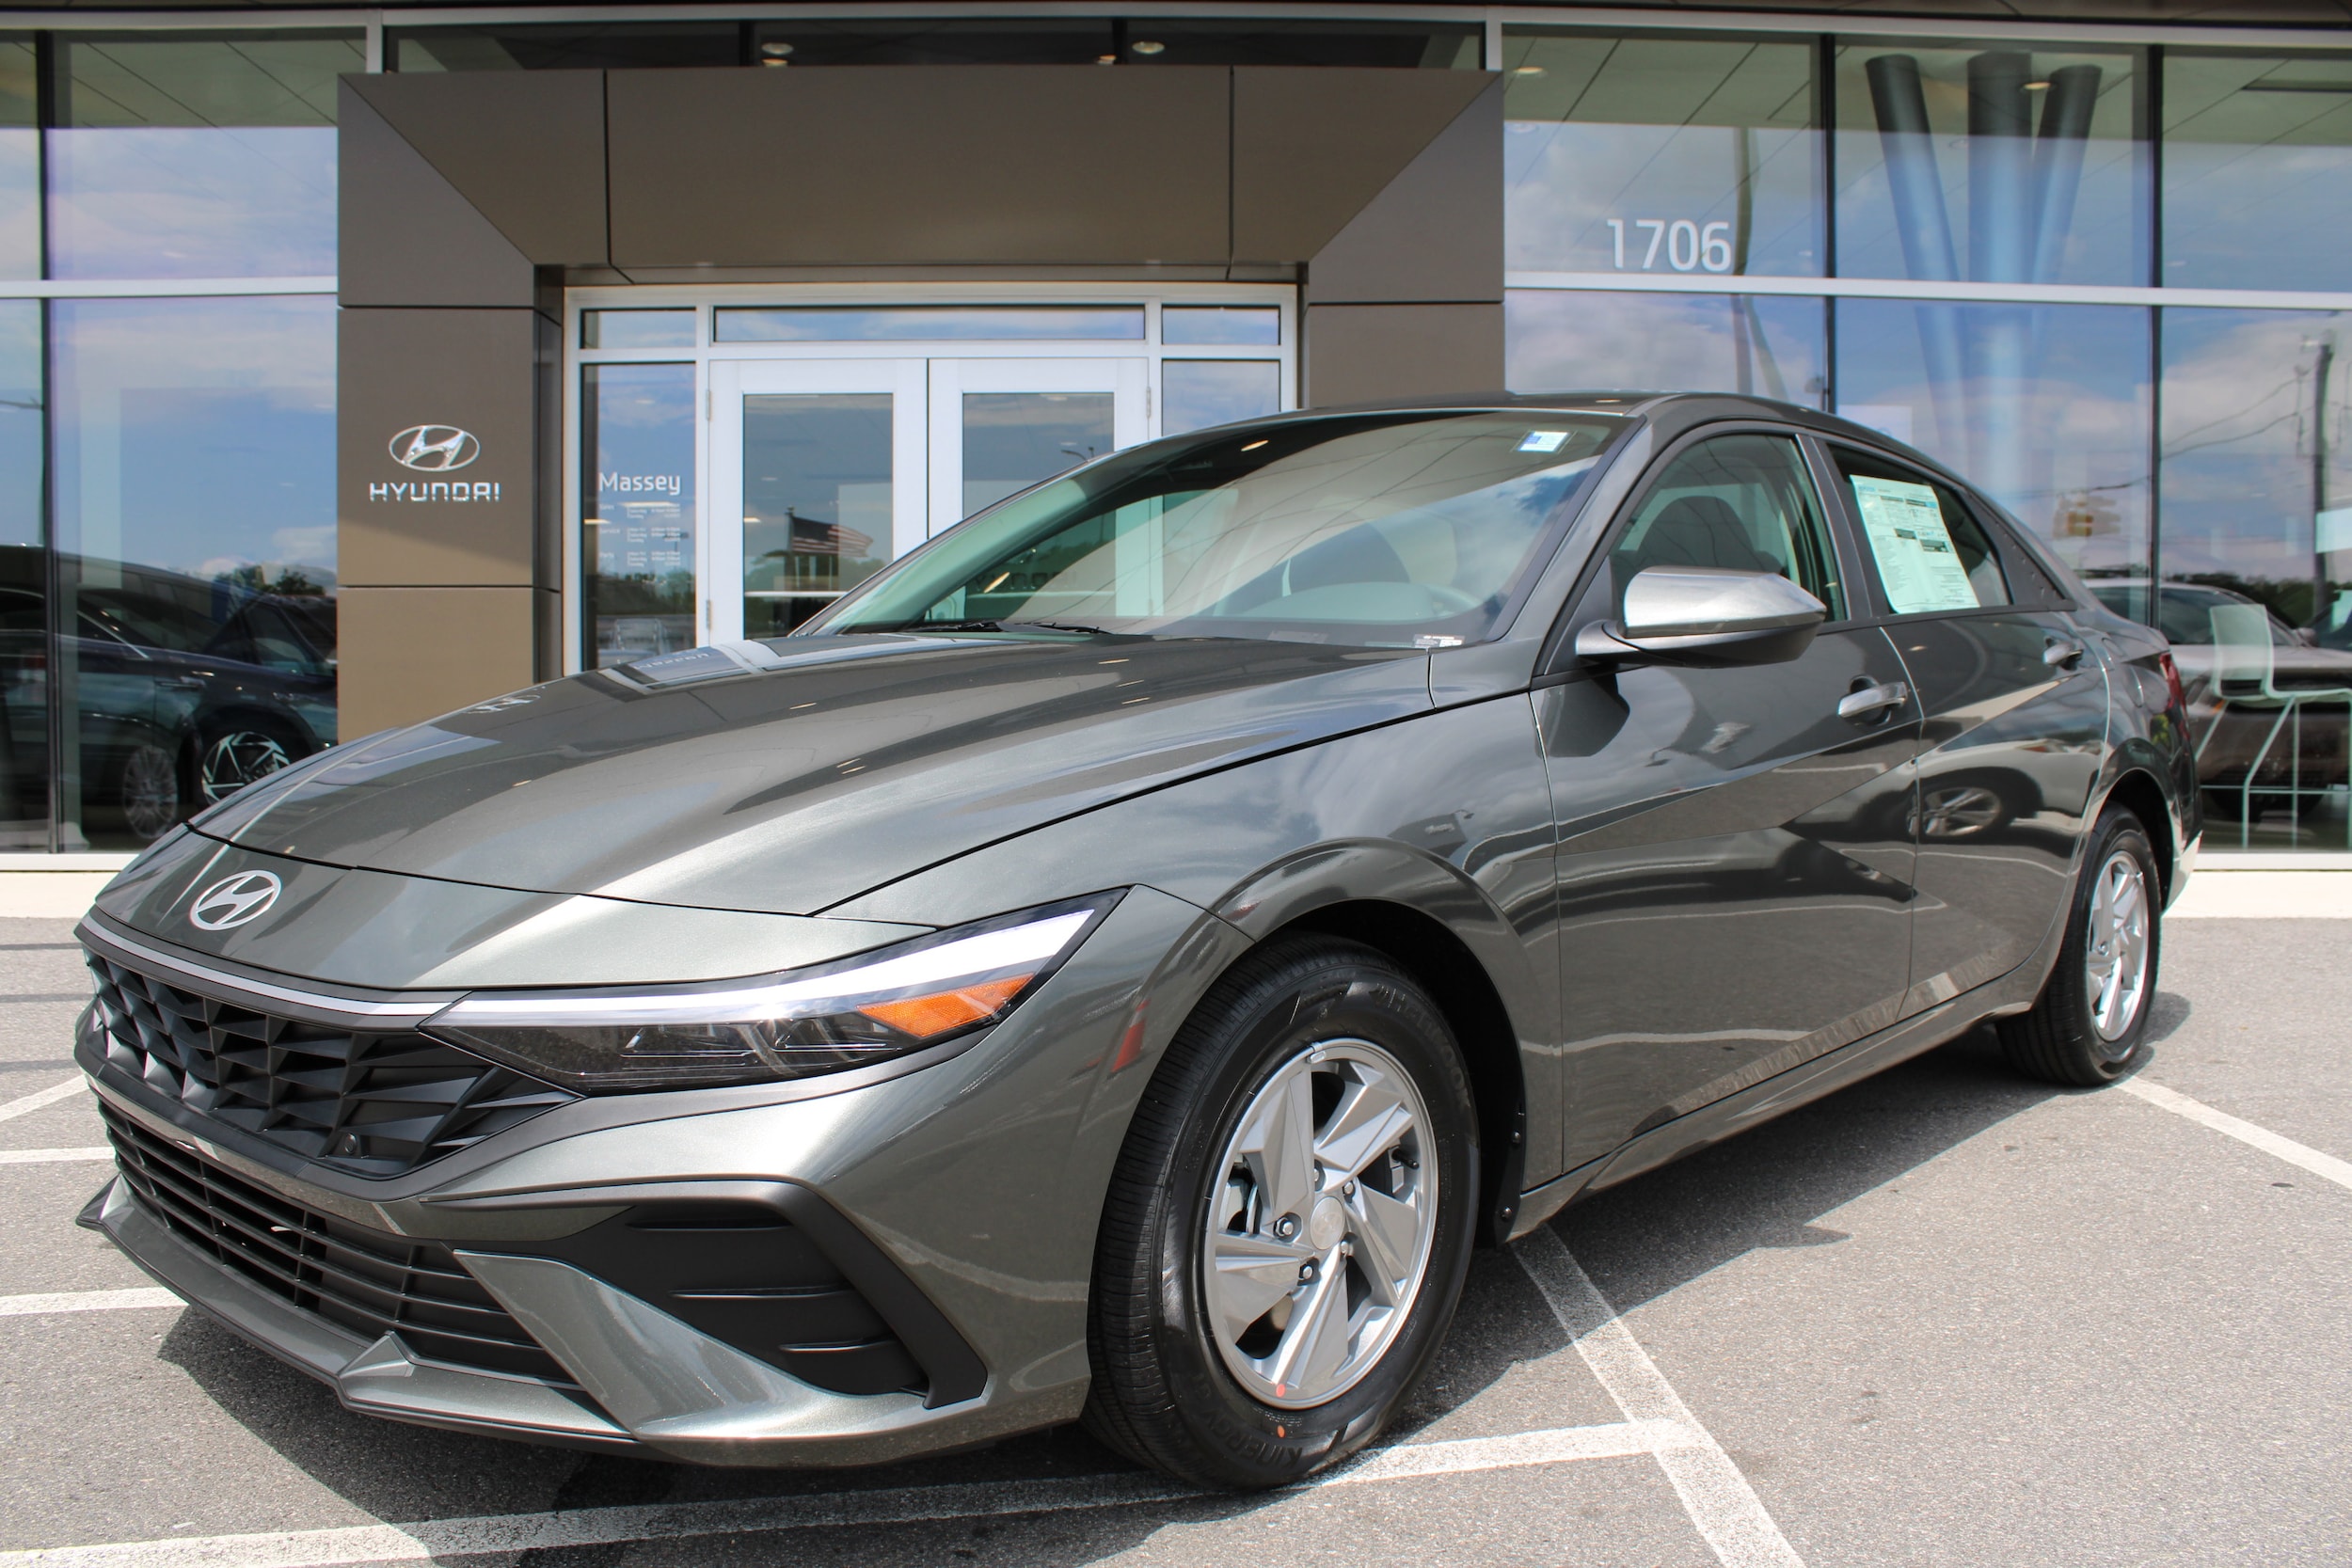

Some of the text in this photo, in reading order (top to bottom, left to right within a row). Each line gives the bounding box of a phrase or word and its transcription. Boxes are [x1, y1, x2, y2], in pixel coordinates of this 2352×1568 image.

[1607, 218, 1732, 272] 1706
[369, 482, 501, 502] HYUNDAI
[598, 472, 681, 496] Massey
